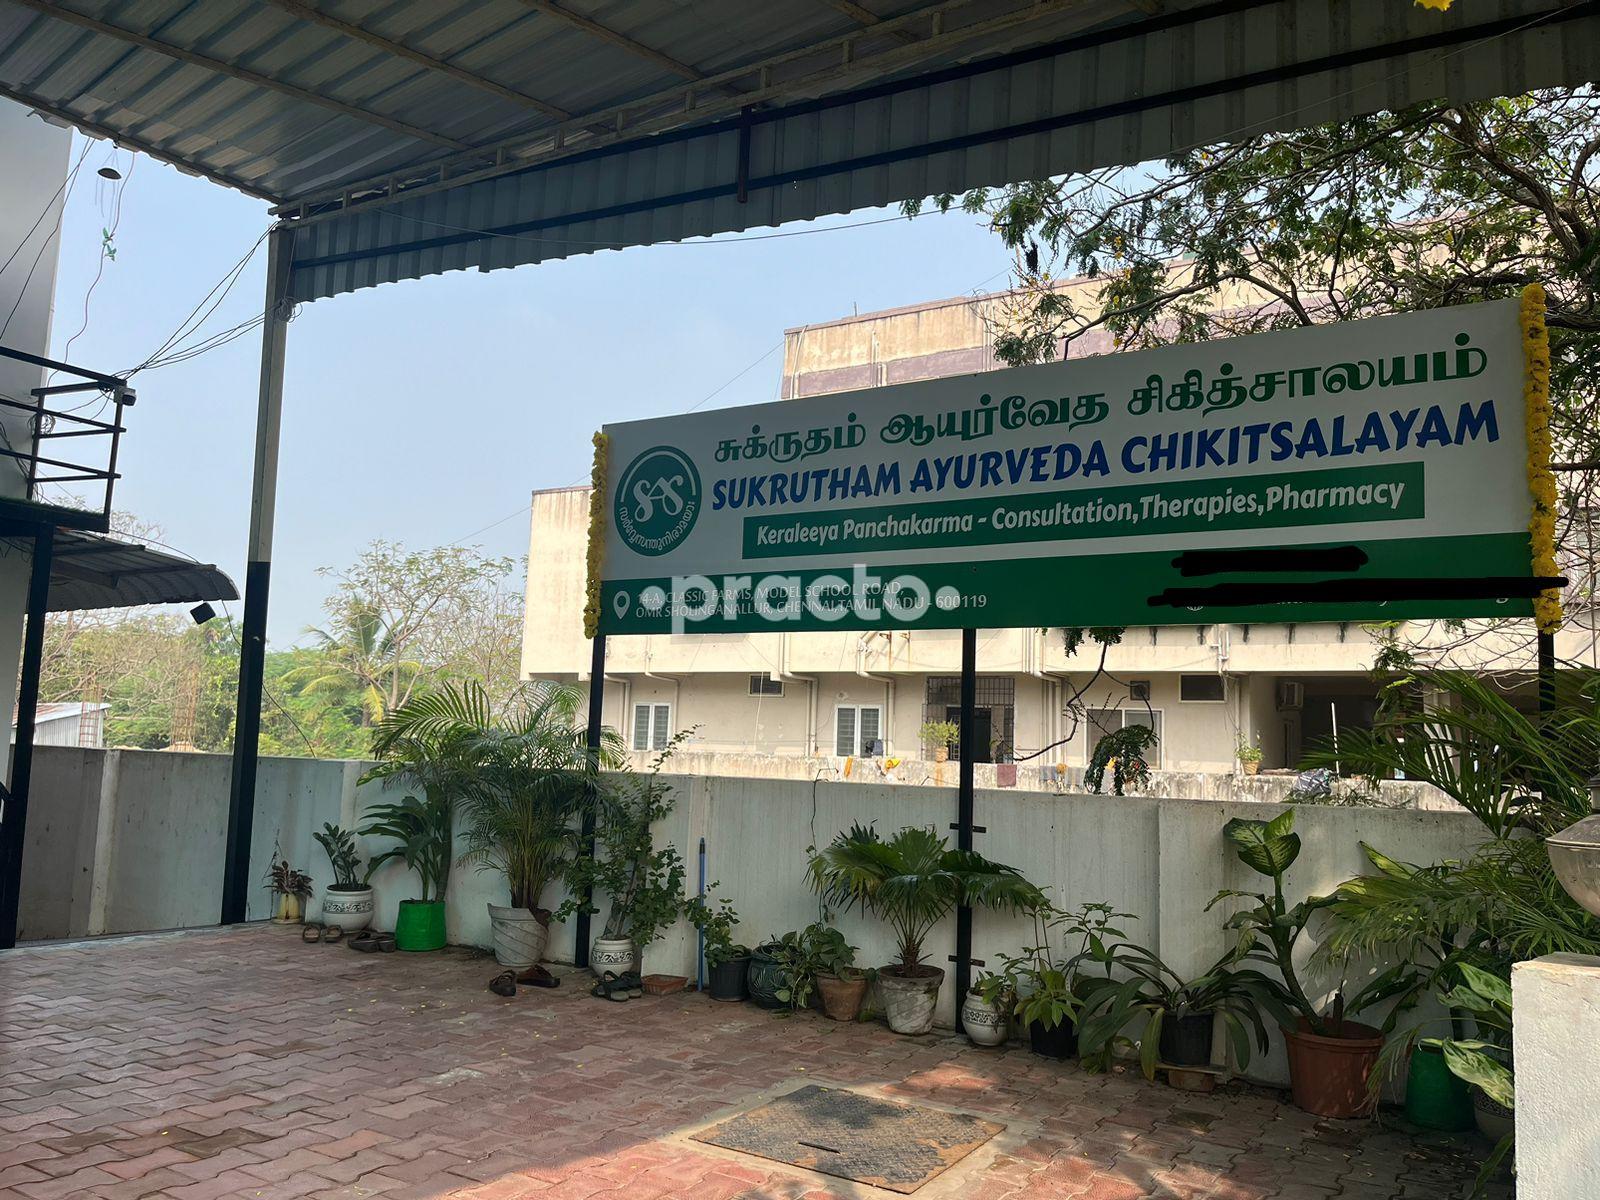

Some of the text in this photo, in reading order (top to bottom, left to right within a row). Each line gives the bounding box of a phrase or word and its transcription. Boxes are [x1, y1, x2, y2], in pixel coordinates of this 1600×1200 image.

[714, 333, 1488, 464] சுக்ருதம் ஆயுர்வேத சிகித்சாலயம்
[713, 399, 1500, 510] SUKRUTHAM AYURVEDA CHIKITSALAYAM
[756, 521, 839, 547] Keraleeya
[843, 513, 973, 540] Panchakarma
[636, 606, 662, 618] OMR
[882, 597, 924, 610] NADU
[935, 594, 987, 608] 600119
[666, 590, 709, 603] CLASSIC
[711, 588, 753, 602] FARMS,
[755, 586, 802, 599] MODEL
[805, 583, 859, 597] SCHOOL
[861, 582, 904, 596] ROAD,
